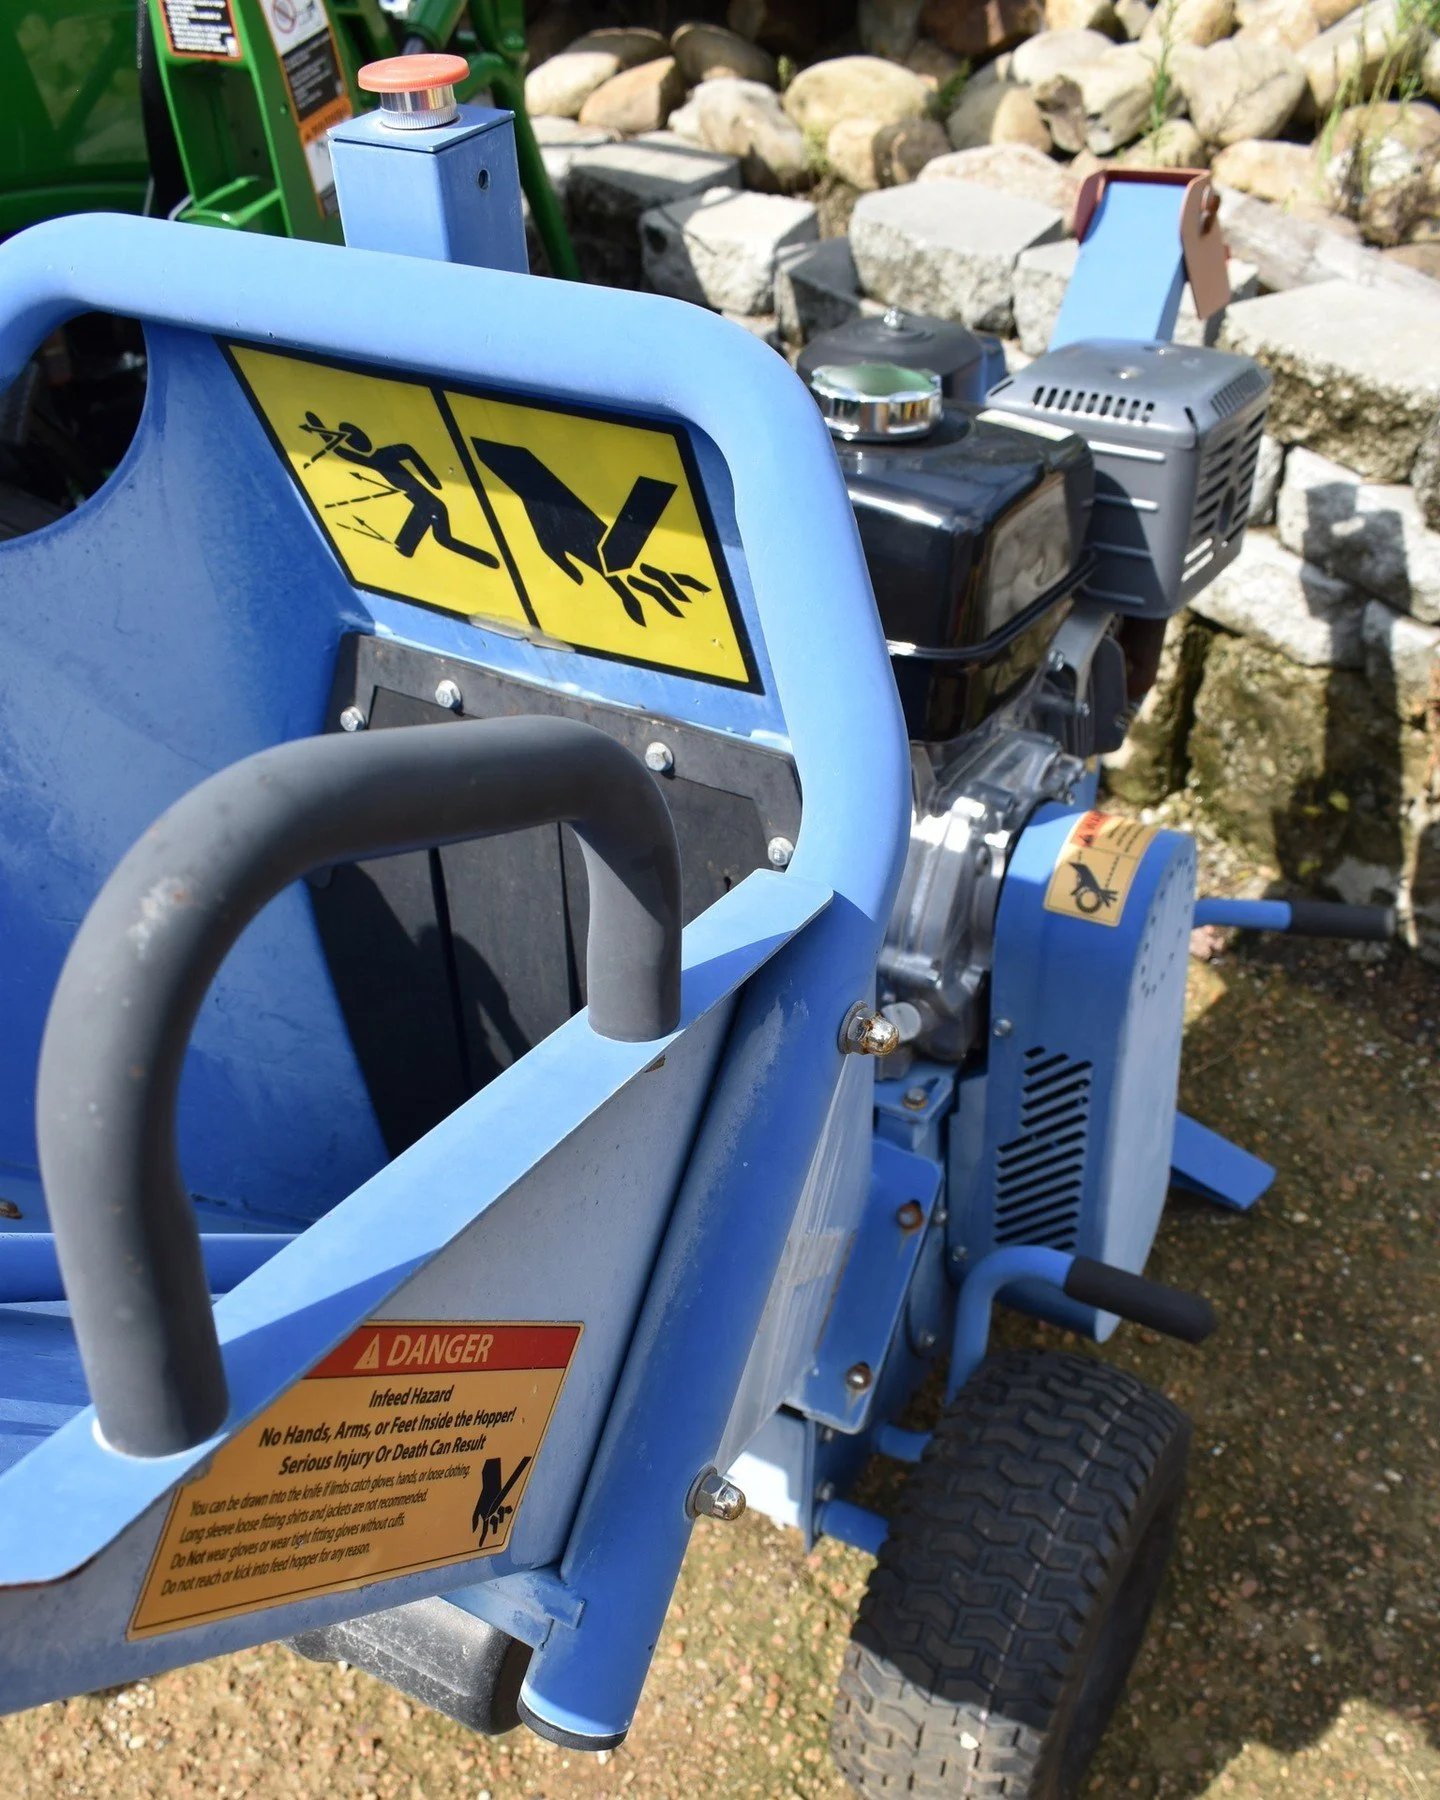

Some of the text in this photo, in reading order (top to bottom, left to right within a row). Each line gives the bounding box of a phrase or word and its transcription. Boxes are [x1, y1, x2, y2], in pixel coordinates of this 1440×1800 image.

[386, 1333, 494, 1366] DANGER
[368, 1385, 455, 1408] Infeed Hazard
[259, 1407, 517, 1447] No Hands, Arms, or Feet Inside the Hopper!
[278, 1434, 487, 1476] Serious Injury Or Death Can Result
[190, 1500, 208, 1517] You
[208, 1501, 226, 1514] can
[227, 1494, 240, 1510] be
[240, 1492, 268, 1509] drawn
[268, 1490, 287, 1505] into
[287, 1487, 302, 1501] the
[302, 1483, 322, 1497] knife
[322, 1481, 331, 1497] if
[329, 1480, 350, 1496] limbs
[351, 1476, 371, 1492] catch
[419, 1471, 427, 1480] or
[426, 1468, 444, 1480] loose
[170, 1553, 185, 1571] Do
[187, 1551, 207, 1566] Not
[207, 1547, 230, 1561] wear
[228, 1541, 258, 1563] gloves
[259, 1540, 271, 1553] or
[270, 1535, 291, 1549] wear
[291, 1532, 312, 1549] tight
[311, 1523, 337, 1543] fitting
[334, 1520, 361, 1542] gloves
[360, 1516, 389, 1534] without
[180, 1526, 205, 1545] Long
[205, 1522, 235, 1539] sleeve
[235, 1518, 260, 1533] loose
[259, 1513, 287, 1530] fitting
[286, 1509, 309, 1526] shirts
[309, 1506, 324, 1521] and
[323, 1502, 352, 1522] jackets
[353, 1502, 365, 1513] are
[364, 1498, 378, 1511] not
[160, 1579, 177, 1597] Do
[177, 1576, 196, 1592] not
[195, 1571, 222, 1589] reach
[222, 1569, 233, 1581] or
[232, 1564, 252, 1580] kick
[251, 1562, 270, 1577] into
[269, 1556, 291, 1572] feed
[289, 1552, 319, 1572] hopper
[318, 1548, 331, 1562] for
[331, 1548, 347, 1562] any
